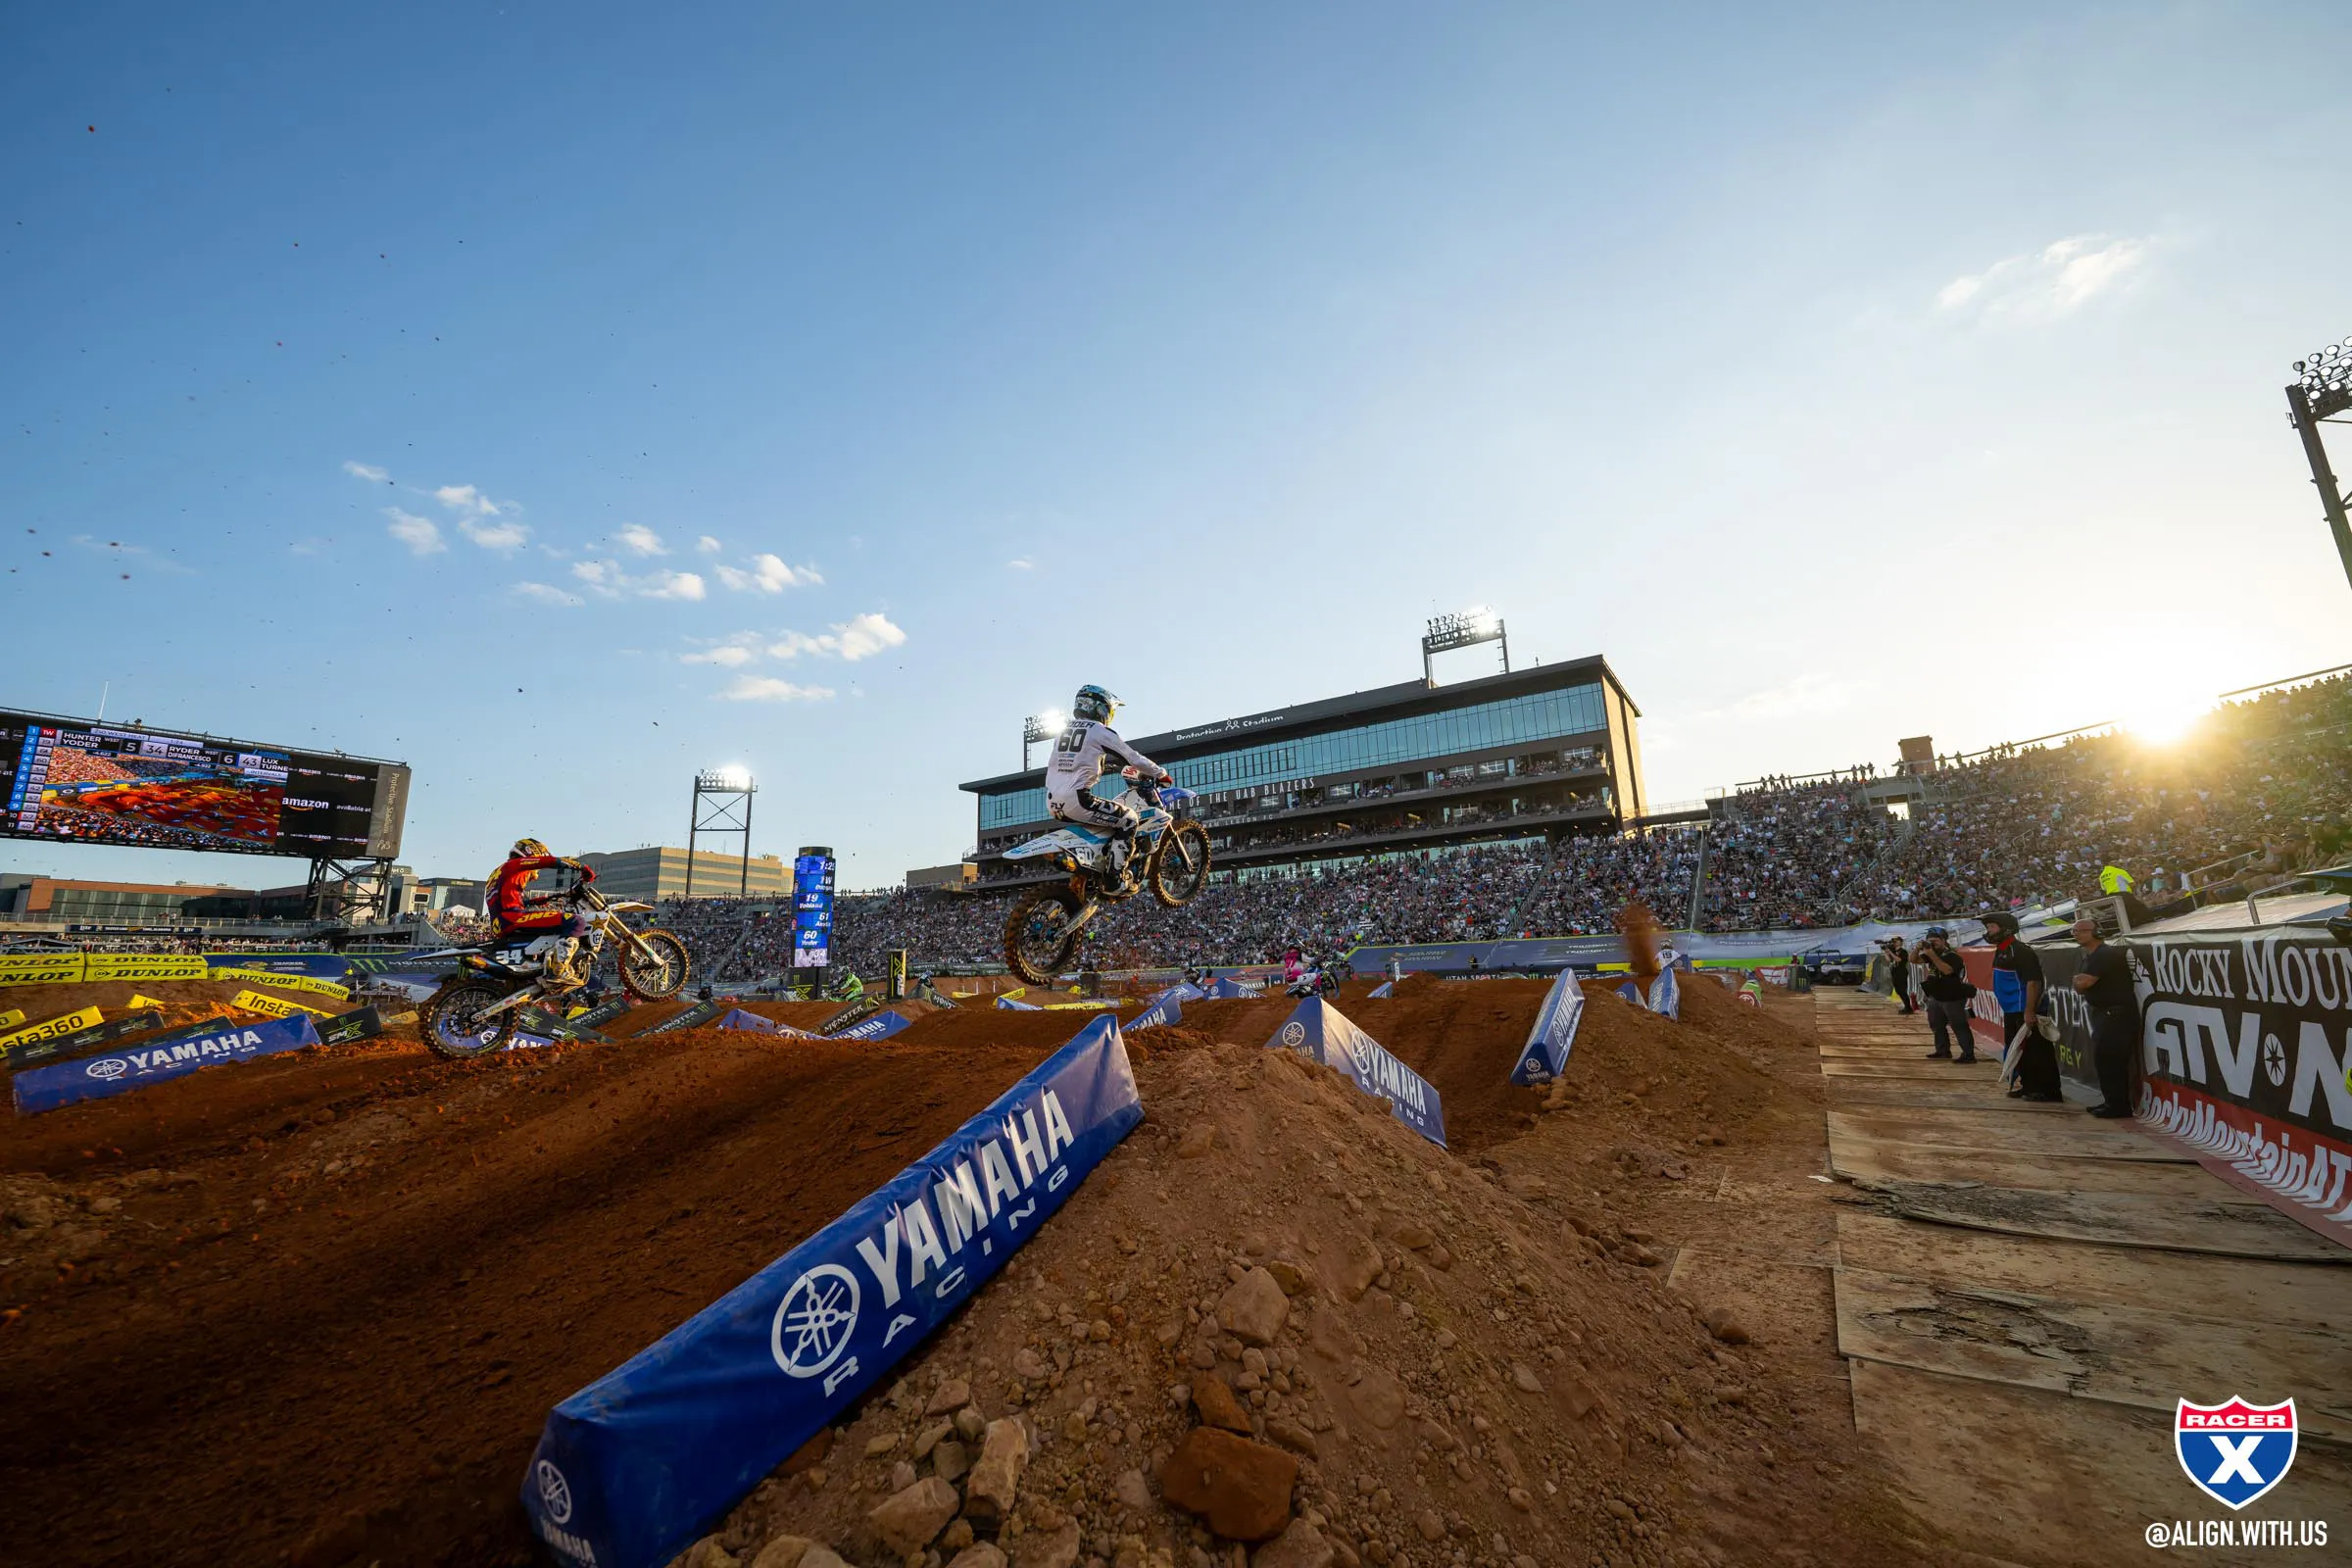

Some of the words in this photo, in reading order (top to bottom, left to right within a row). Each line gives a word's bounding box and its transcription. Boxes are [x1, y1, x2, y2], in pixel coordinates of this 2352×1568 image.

[1243, 715, 1284, 727] Stadium
[64, 732, 102, 742] HUNTER
[1057, 728, 1088, 753] 60
[62, 739, 99, 748] YODER
[125, 742, 136, 752] 5
[146, 745, 164, 755] 34
[168, 753, 212, 762] DIFRANCESCO
[223, 755, 234, 763] 6
[242, 758, 258, 766] 43
[1189, 796, 1200, 807] OF
[1209, 792, 1228, 804] THE
[1236, 788, 1256, 800] UAB
[1264, 778, 1315, 796] BLAZERS
[282, 797, 329, 809] amazon
[806, 893, 818, 902] 19
[804, 930, 817, 939] 60
[113, 956, 203, 964] DUNLOP
[495, 949, 523, 965] 34
[113, 968, 202, 978] DUNLOP
[2151, 940, 2235, 999] ROCKY
[0, 970, 75, 982] NLOP
[237, 973, 298, 986] DUNLOP
[314, 983, 347, 998] DUNLOP
[0, 1015, 84, 1057] sta360
[128, 1030, 263, 1068] YAMAHA
[2143, 1001, 2261, 1099] ATV
[1369, 1042, 1427, 1116] YAMAHA
[856, 1090, 1075, 1310] YAMAHA
[823, 1163, 1069, 1397] RACING
[540, 1514, 597, 1564] YAMAHA
